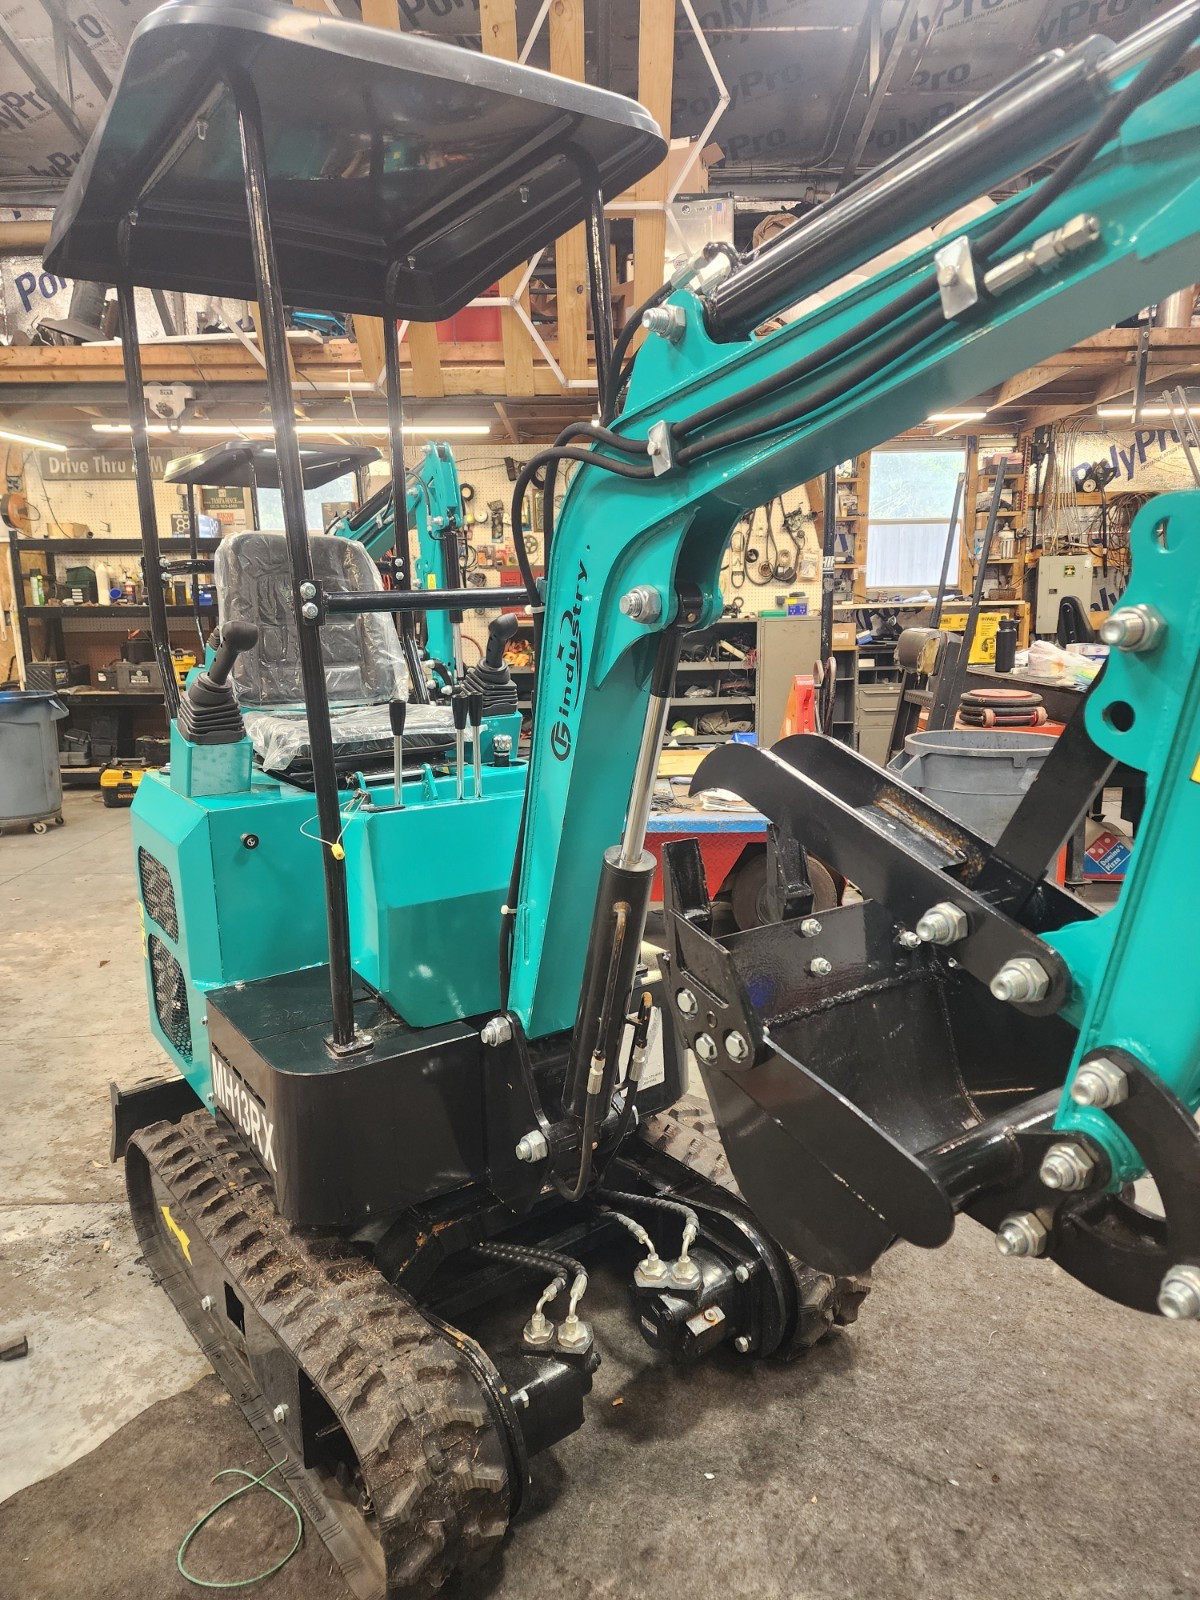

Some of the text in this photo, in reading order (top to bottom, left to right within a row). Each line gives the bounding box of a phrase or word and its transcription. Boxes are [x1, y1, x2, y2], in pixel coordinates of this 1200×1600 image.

[48, 456, 89, 474] Drive
[93, 456, 127, 473] Thru
[559, 559, 588, 718] industry
[1100, 845, 1125, 866] Domino's
[1105, 857, 1121, 871] Pizza
[211, 1052, 278, 1173] MH13RX
